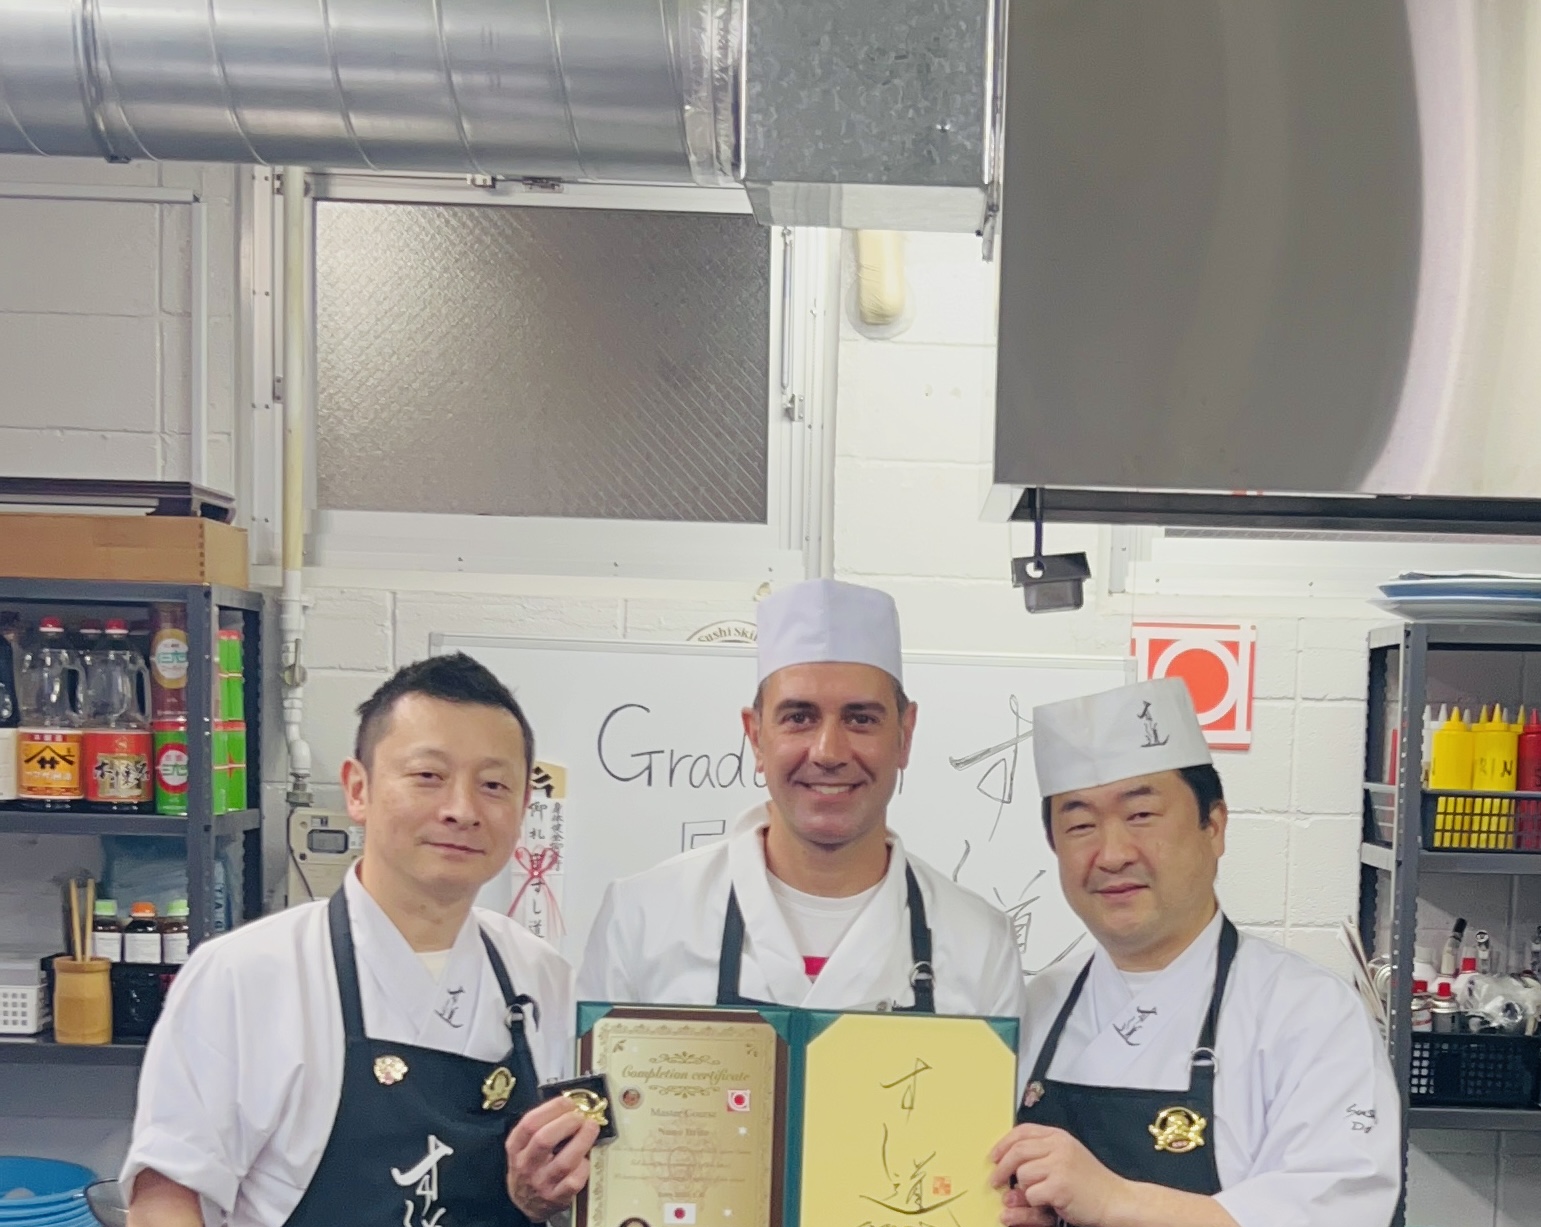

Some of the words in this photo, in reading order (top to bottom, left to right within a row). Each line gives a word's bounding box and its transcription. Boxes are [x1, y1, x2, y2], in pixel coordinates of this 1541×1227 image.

[697, 627, 732, 642] Sushi
[622, 1065, 689, 1083] Completion
[691, 1067, 750, 1085] certificate
